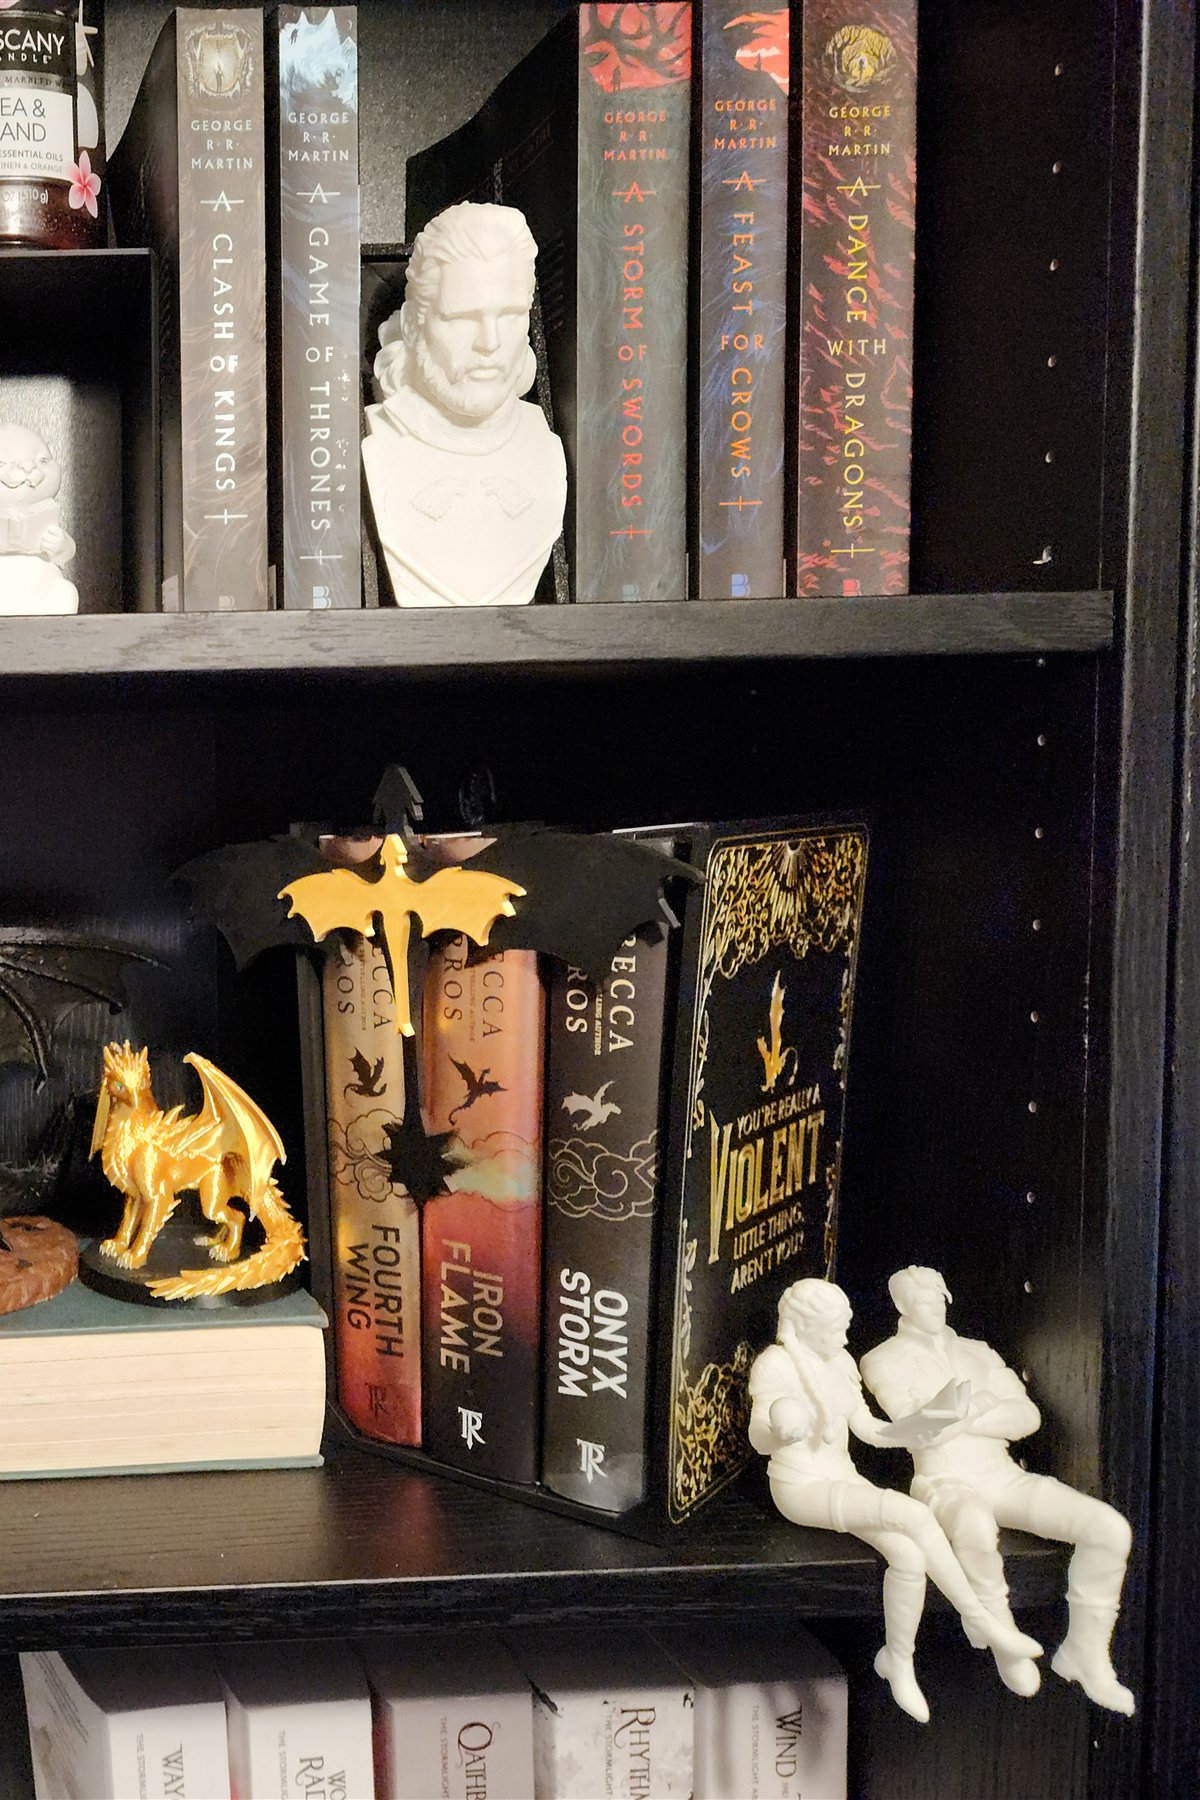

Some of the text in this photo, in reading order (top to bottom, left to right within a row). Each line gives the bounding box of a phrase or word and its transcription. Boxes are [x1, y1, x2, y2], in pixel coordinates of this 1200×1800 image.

[6, 75, 52, 86] MARBLED
[32, 98, 46, 118] &
[714, 99, 776, 112] GEORGE
[191, 119, 252, 132] GEORGE
[288, 112, 349, 124] GEORGE
[604, 111, 668, 123] GEORGE
[829, 105, 891, 119] GEORGE
[30, 162, 63, 174] ORANGE
[45, 151, 64, 162] OILS
[191, 158, 253, 169] MARTIN
[288, 150, 349, 162] MARTIN
[603, 148, 667, 161] MARTIN
[714, 137, 776, 150] MARTIN
[828, 143, 891, 156] MARTIN
[212, 233, 234, 339] CLASH
[308, 227, 329, 326] GAME
[623, 224, 645, 330] STORM
[732, 211, 754, 316] FEAST
[846, 214, 869, 323] DANCE
[210, 355, 239, 373] OF
[305, 346, 334, 363] OF
[618, 344, 647, 361] OF
[721, 334, 764, 350] FOR
[827, 338, 887, 356] WITH
[214, 390, 236, 491] KINGS
[621, 378, 643, 508] SWORDS
[731, 367, 752, 479] CROWS
[843, 373, 866, 527] DRAGONS
[310, 381, 331, 531] THRONES
[737, 1083, 821, 1139] YOU'RE REALLY A
[708, 1109, 826, 1265] VIOLENT
[733, 1221, 766, 1261] LITTLE
[346, 1243, 372, 1331] WING
[371, 1224, 404, 1358] FOURTH
[730, 1247, 774, 1295] AREN'T
[440, 1239, 471, 1375] FLAME
[472, 1269, 503, 1358] IRON
[558, 1268, 591, 1398] STORM
[592, 1289, 629, 1399] ONYX
[440, 1717, 450, 1799] THE STORMLIGHT
[606, 1733, 614, 1796] STORMLIGHT
[752, 1724, 760, 1785] STORMLIGHT
[775, 1704, 803, 1778] WIND
